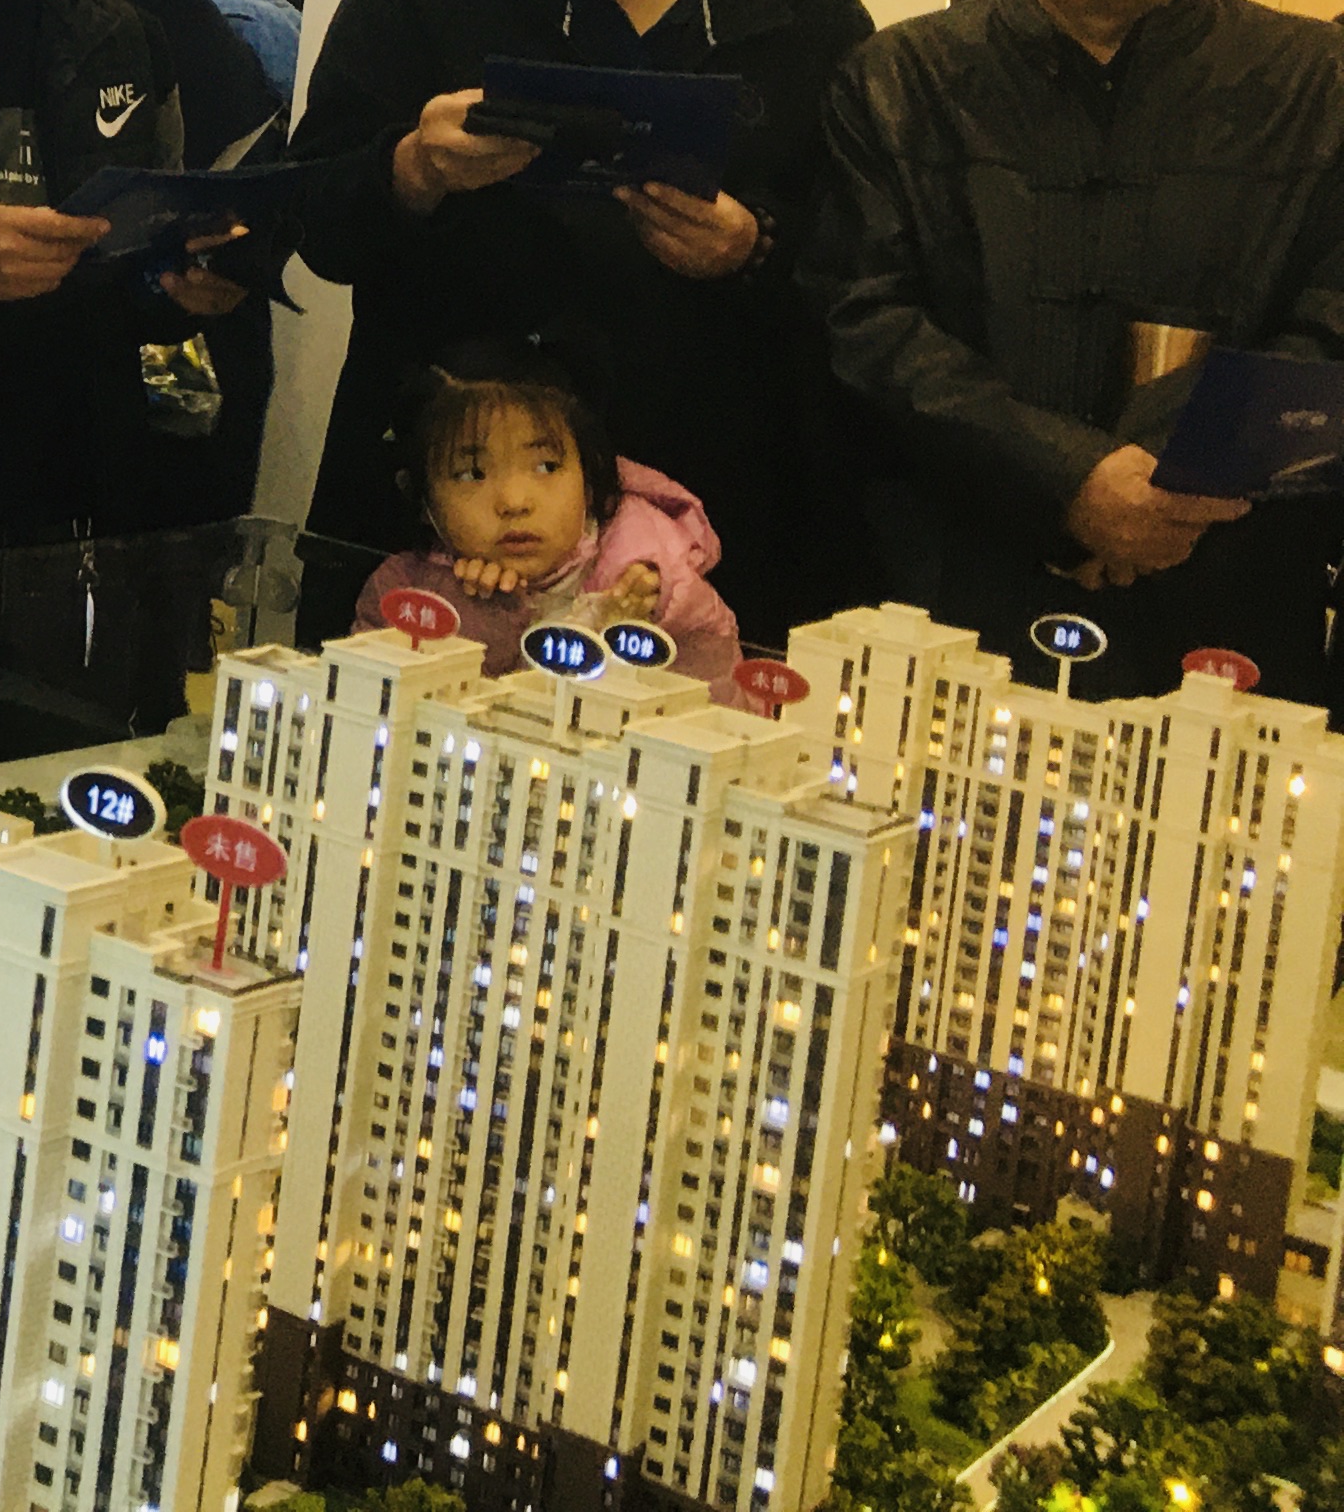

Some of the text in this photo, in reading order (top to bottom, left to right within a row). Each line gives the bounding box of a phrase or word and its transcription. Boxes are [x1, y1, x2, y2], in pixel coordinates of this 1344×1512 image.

[100, 83, 135, 109] NIKE
[542, 634, 585, 667] 11#
[618, 630, 654, 659] 10#
[1054, 626, 1081, 649] 8#
[87, 784, 135, 826] 12#
[205, 833, 257, 873] 未售
